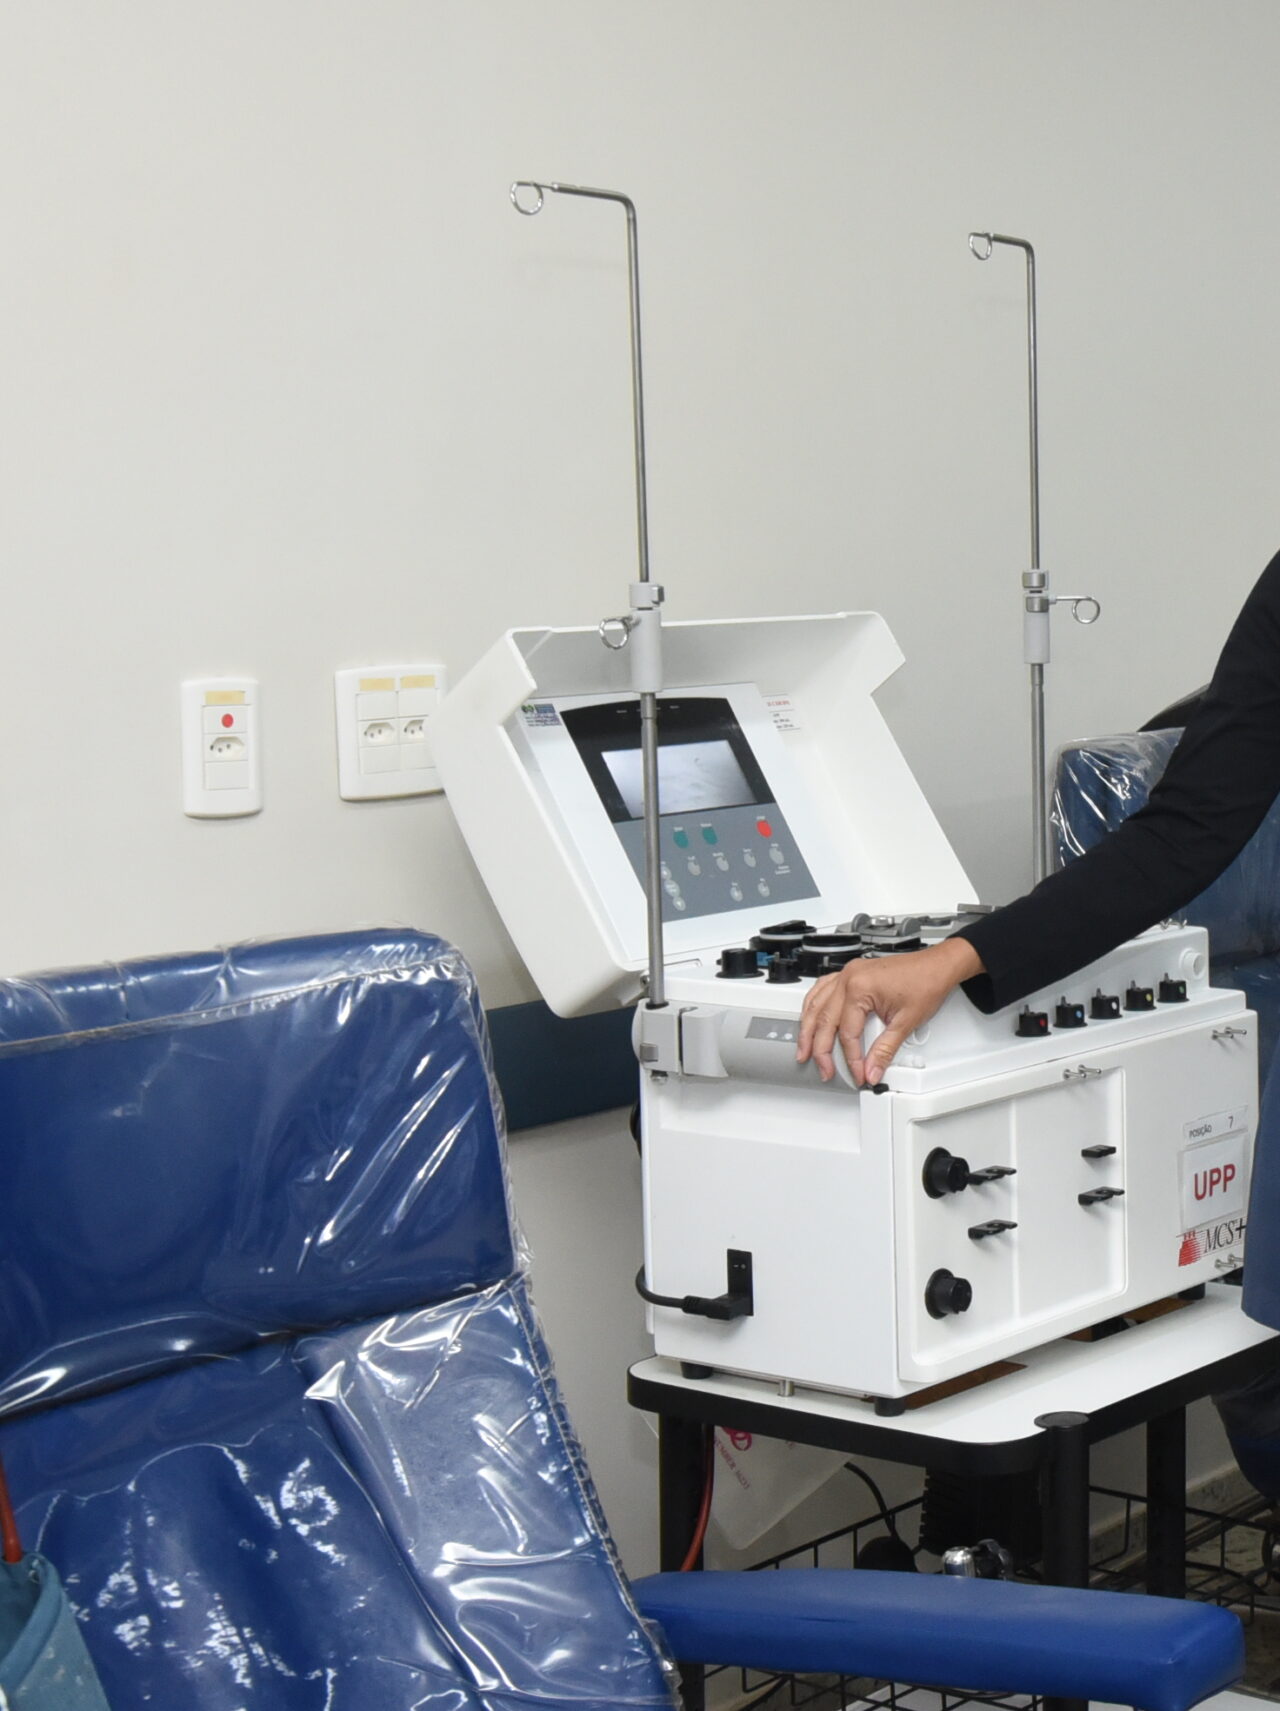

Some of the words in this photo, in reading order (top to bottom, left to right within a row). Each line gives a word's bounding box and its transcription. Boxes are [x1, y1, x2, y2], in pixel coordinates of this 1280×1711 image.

[1189, 1124, 1212, 1138] POSIÇÃO
[1228, 1116, 1234, 1129] 7
[1194, 1163, 1236, 1200] UPP
